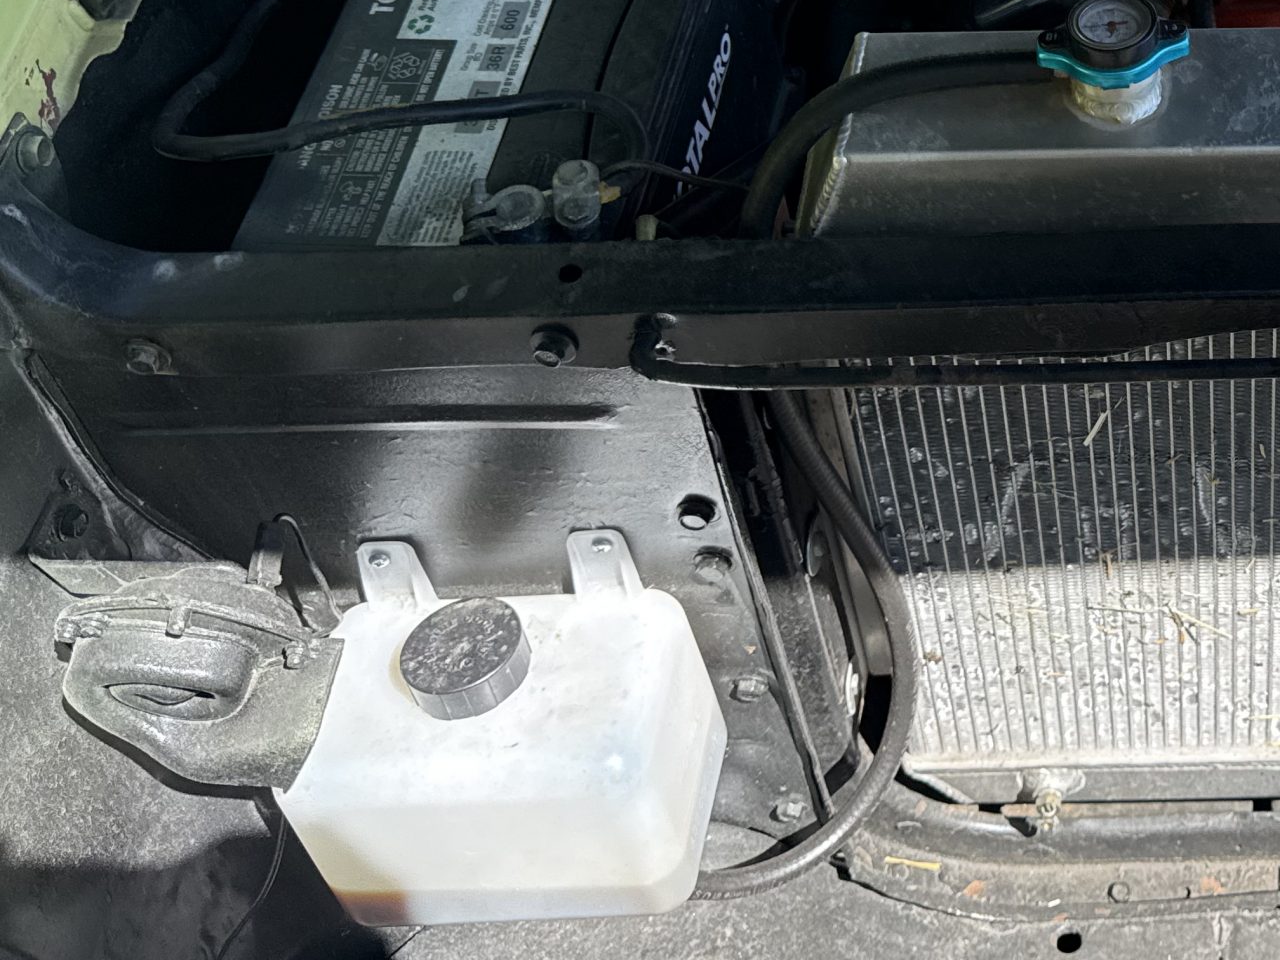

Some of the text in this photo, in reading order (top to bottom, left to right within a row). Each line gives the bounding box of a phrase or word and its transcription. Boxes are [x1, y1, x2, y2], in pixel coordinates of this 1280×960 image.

[500, 9, 520, 30] 600
[486, 46, 507, 69] 36R
[506, 59, 521, 75] BEST
